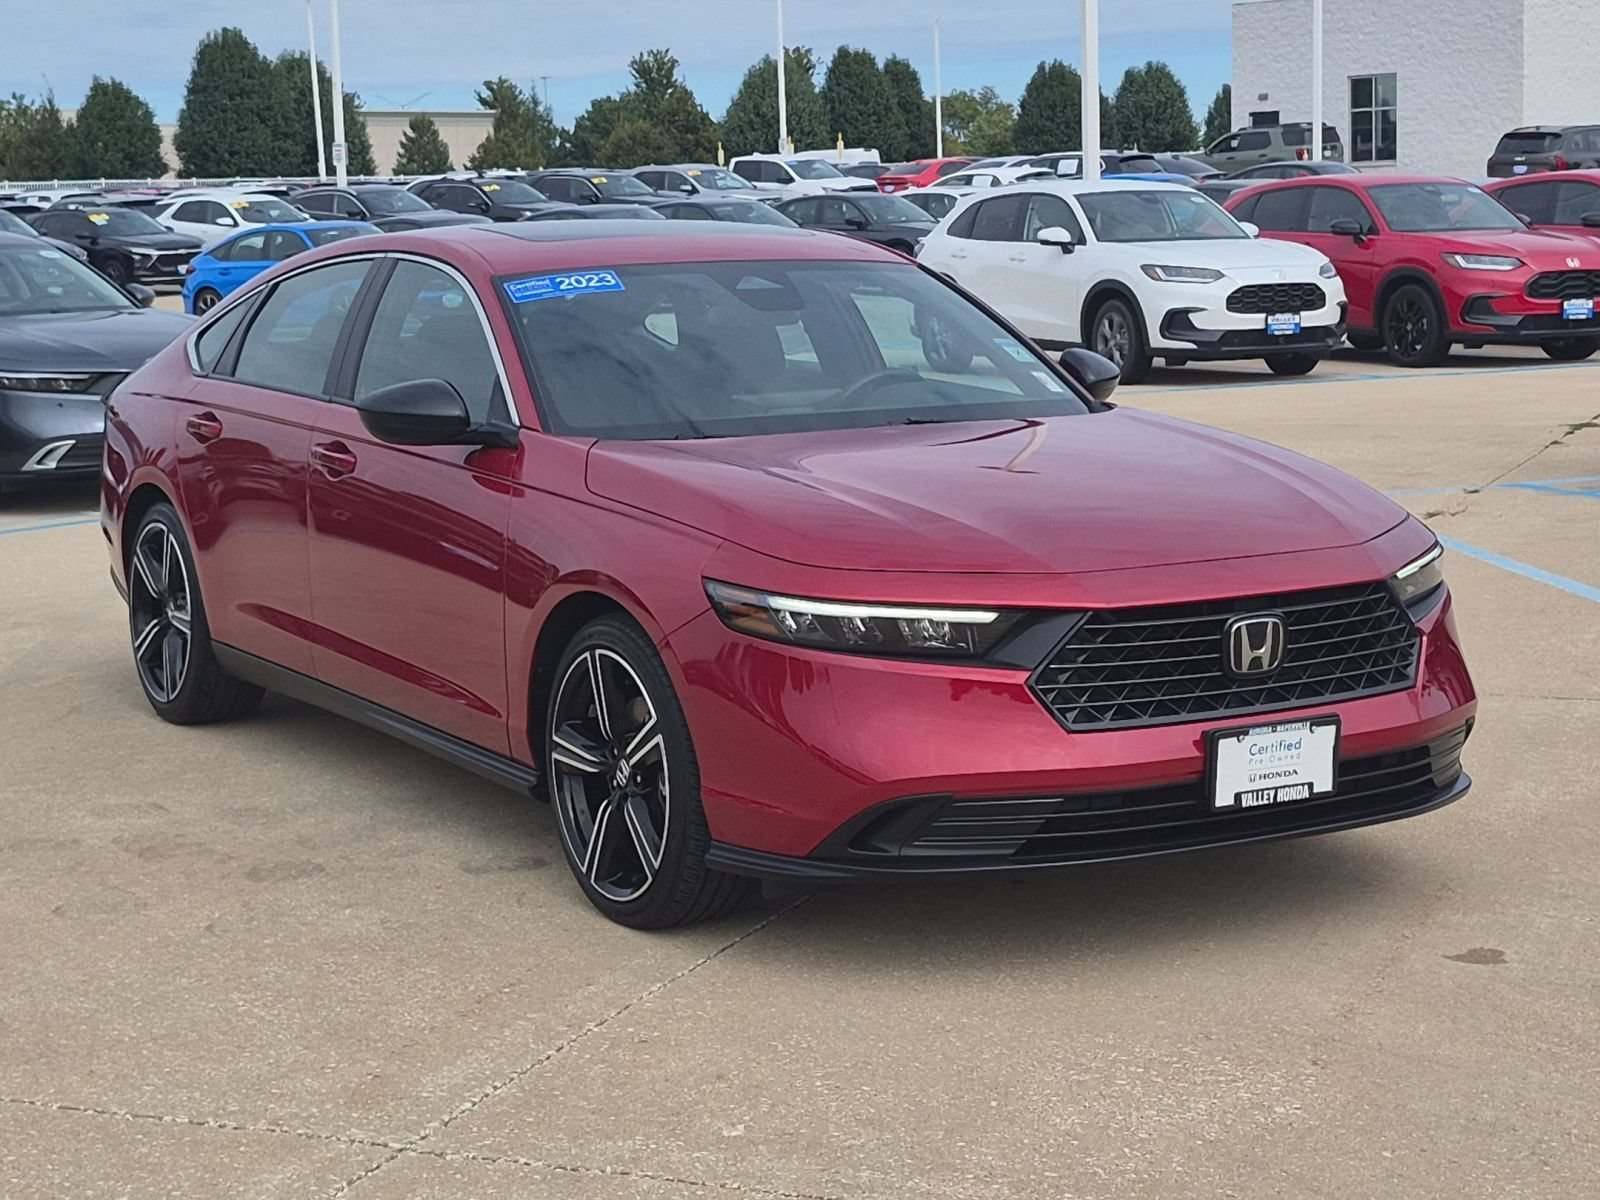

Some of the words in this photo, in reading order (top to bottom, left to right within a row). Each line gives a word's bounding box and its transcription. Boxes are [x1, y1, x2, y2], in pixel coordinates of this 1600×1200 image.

[555, 273, 617, 290] 2023
[1248, 737, 1302, 756] Certified
[1258, 769, 1299, 781] HONDA
[1241, 788, 1276, 808] VALLEY
[1276, 784, 1310, 803] HONDA
